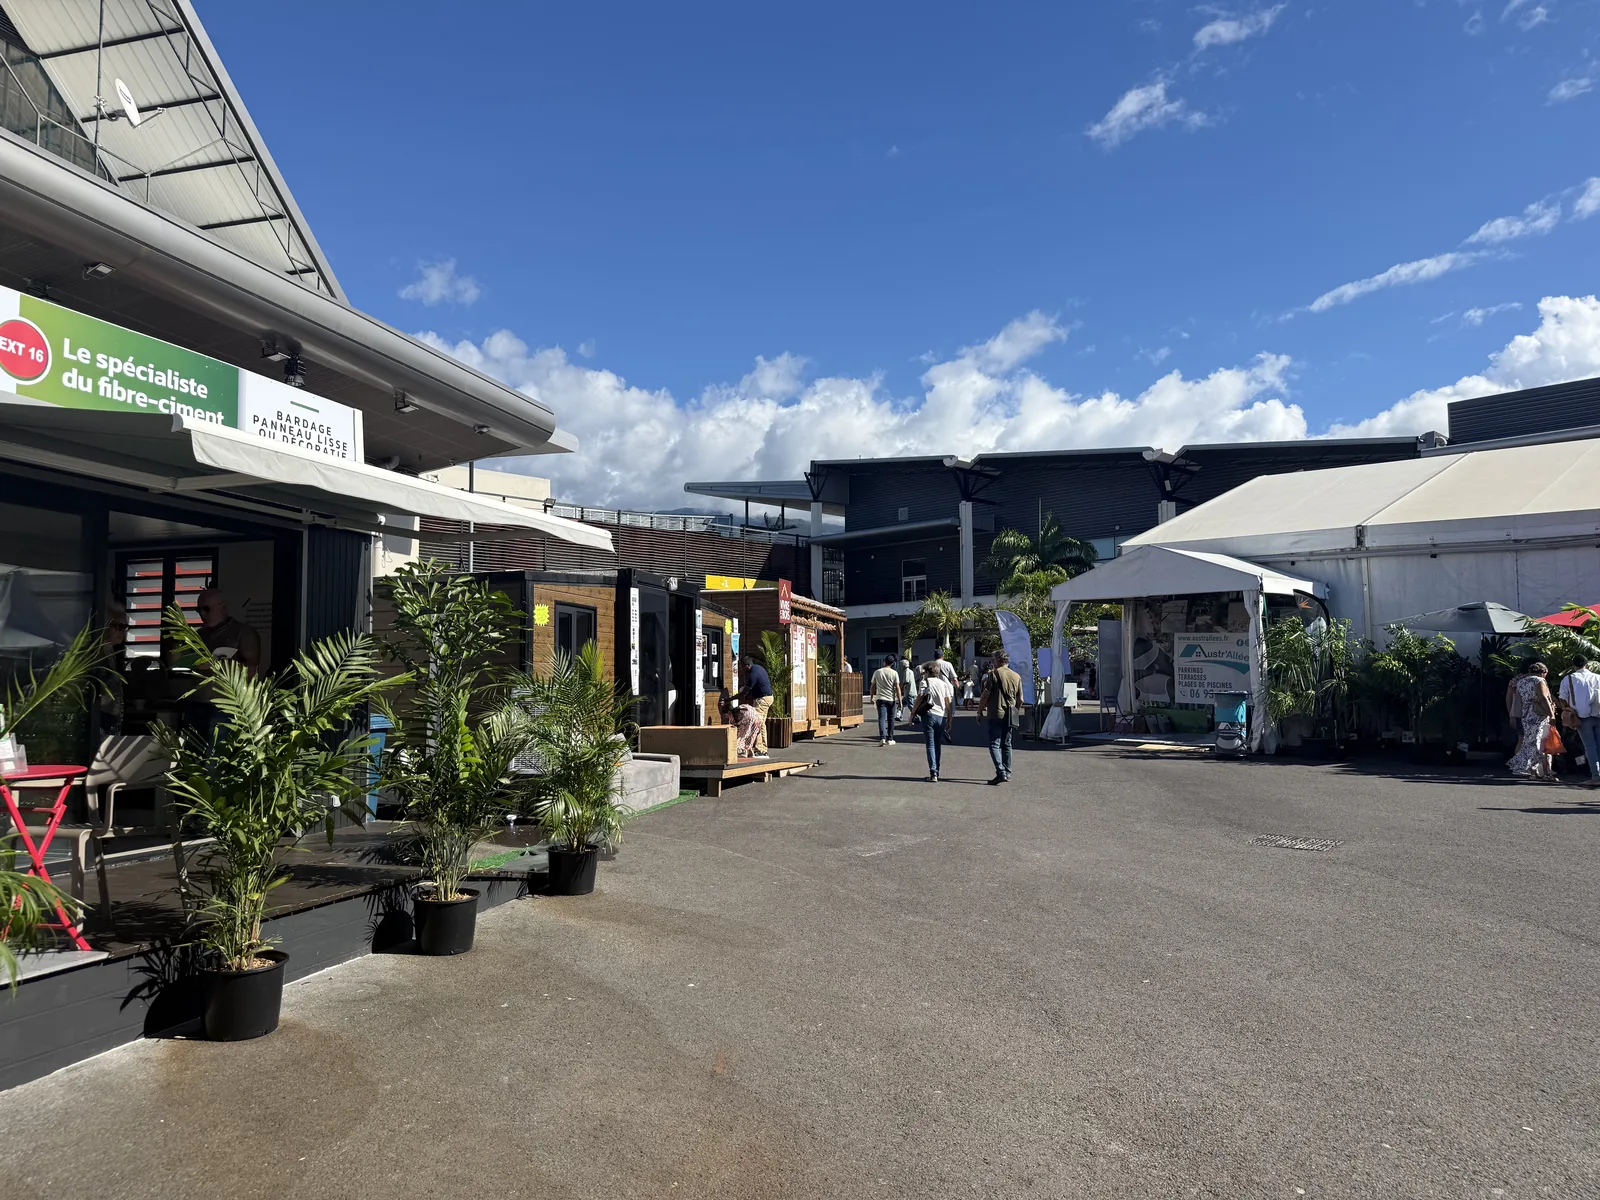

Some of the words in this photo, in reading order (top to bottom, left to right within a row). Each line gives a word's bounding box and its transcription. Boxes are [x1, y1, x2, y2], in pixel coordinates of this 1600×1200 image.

[0, 336, 25, 356] EXT
[28, 347, 44, 363] 16
[63, 337, 91, 365] Le
[96, 353, 208, 399] spécialiste
[62, 368, 93, 393] du
[97, 375, 224, 425] fibre-ciment
[253, 415, 312, 440] PANNEAU
[318, 434, 348, 451] LISSE
[276, 411, 332, 436] BARDAGE
[1179, 644, 1250, 662] Austr'Allée
[1189, 688, 1200, 699] 06
